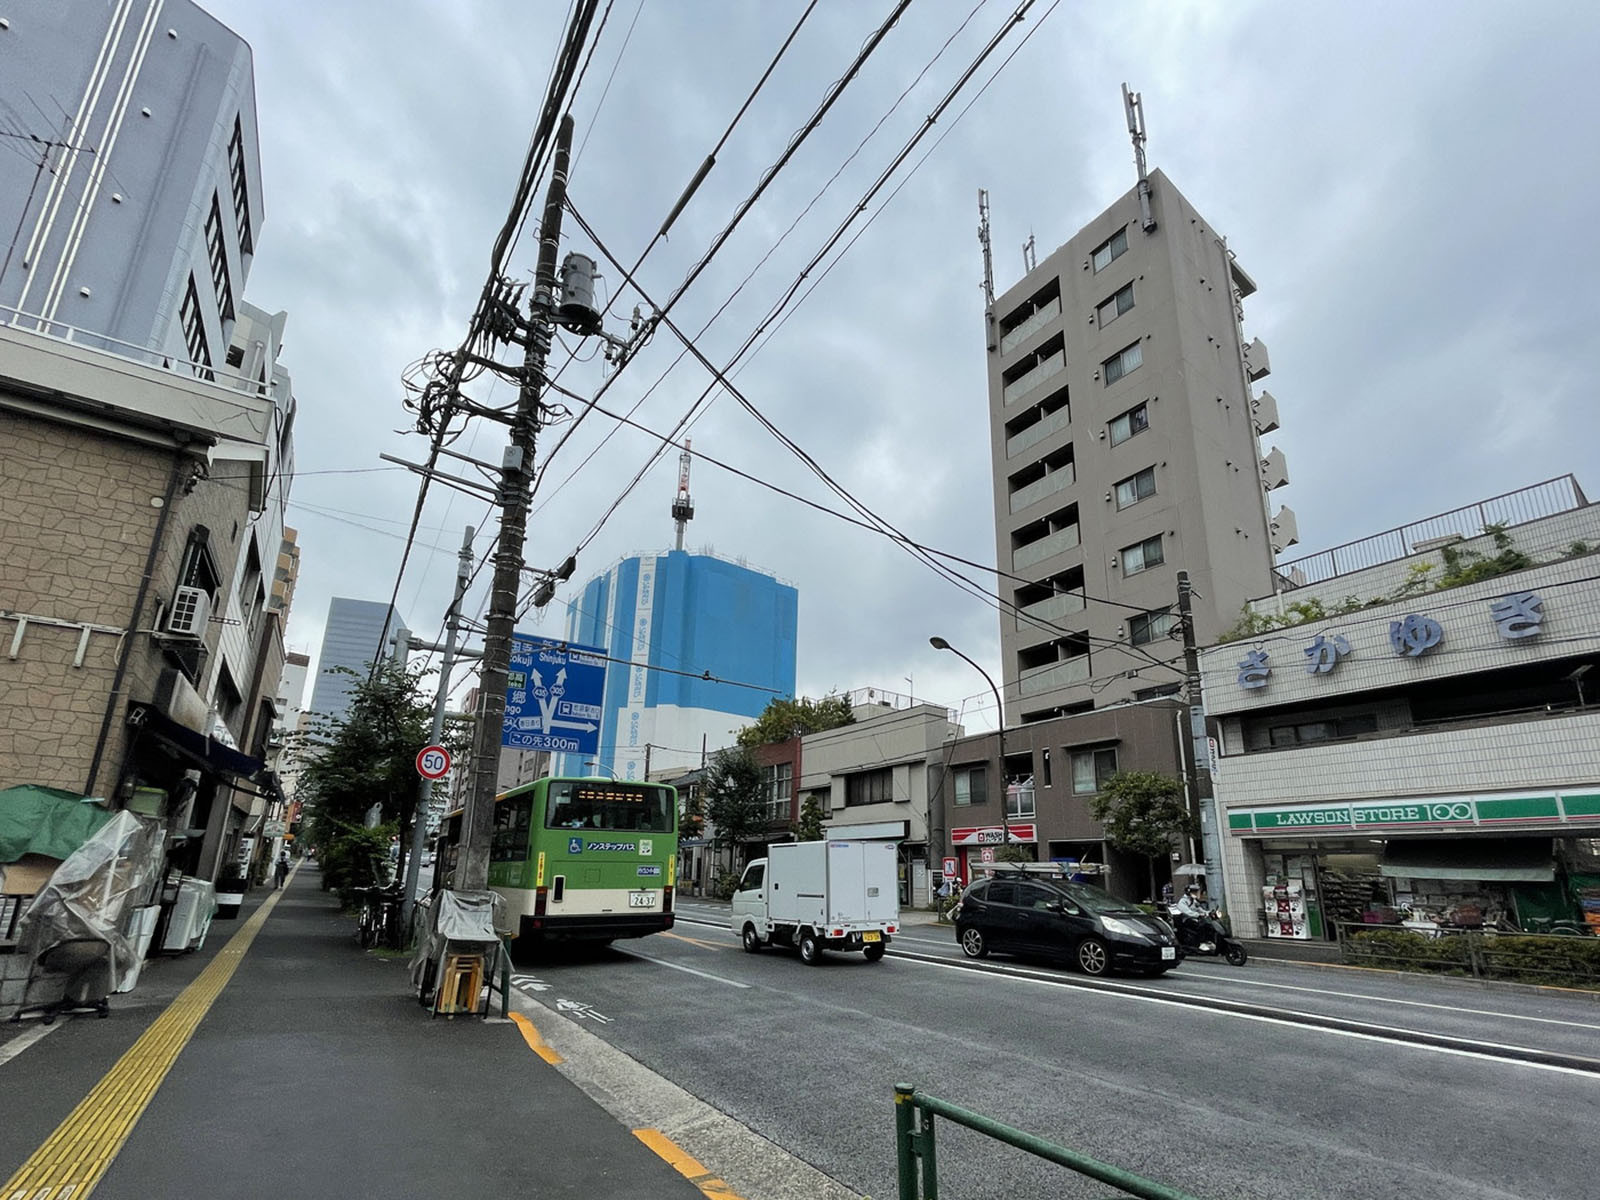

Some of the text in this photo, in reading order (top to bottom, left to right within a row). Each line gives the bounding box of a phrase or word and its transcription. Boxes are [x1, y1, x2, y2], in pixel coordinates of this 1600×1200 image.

[1237, 591, 1545, 689] さかゆき
[539, 651, 567, 665] Shinjuku
[511, 735, 578, 750] この先300m
[424, 754, 443, 770] 50
[1276, 803, 1472, 825] LAWSON STORE 100
[588, 842, 635, 850] ノンステップバス
